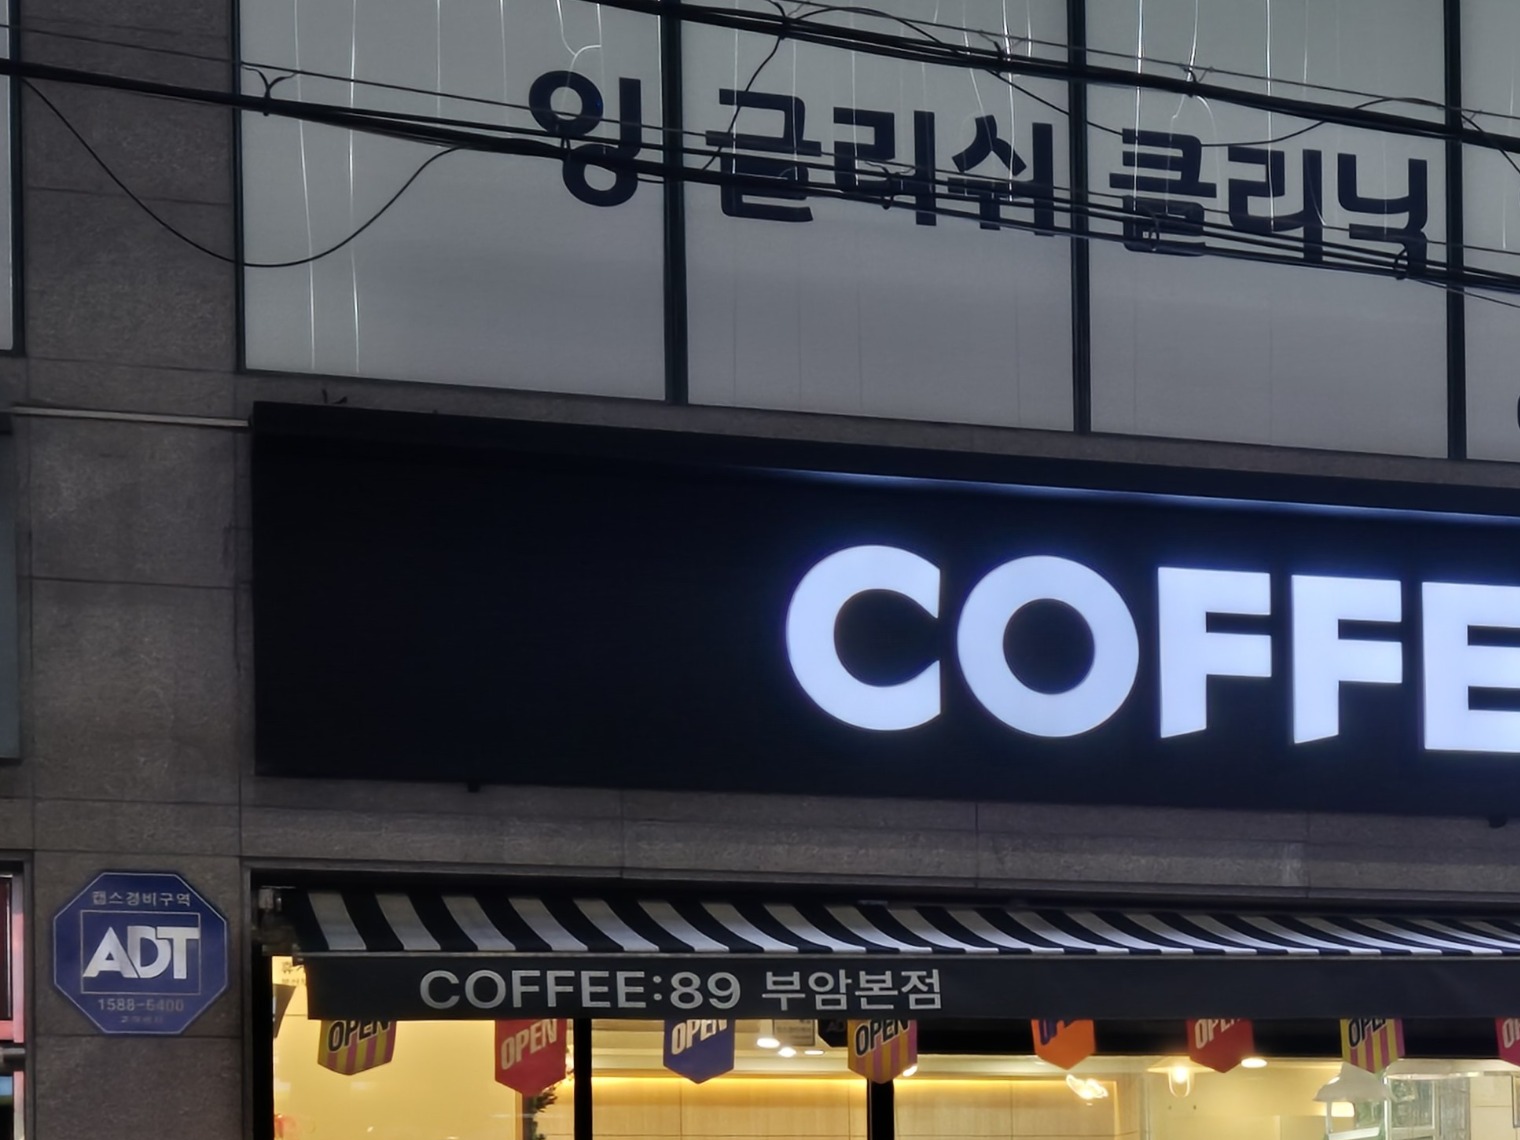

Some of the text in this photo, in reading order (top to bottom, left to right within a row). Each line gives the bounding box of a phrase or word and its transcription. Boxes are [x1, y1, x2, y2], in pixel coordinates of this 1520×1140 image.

[1110, 128, 1428, 274] 클리닉
[82, 925, 200, 980] ADT
[419, 968, 942, 1011] COFFEE:89 부암본점
[501, 1018, 557, 1070] OPEN
